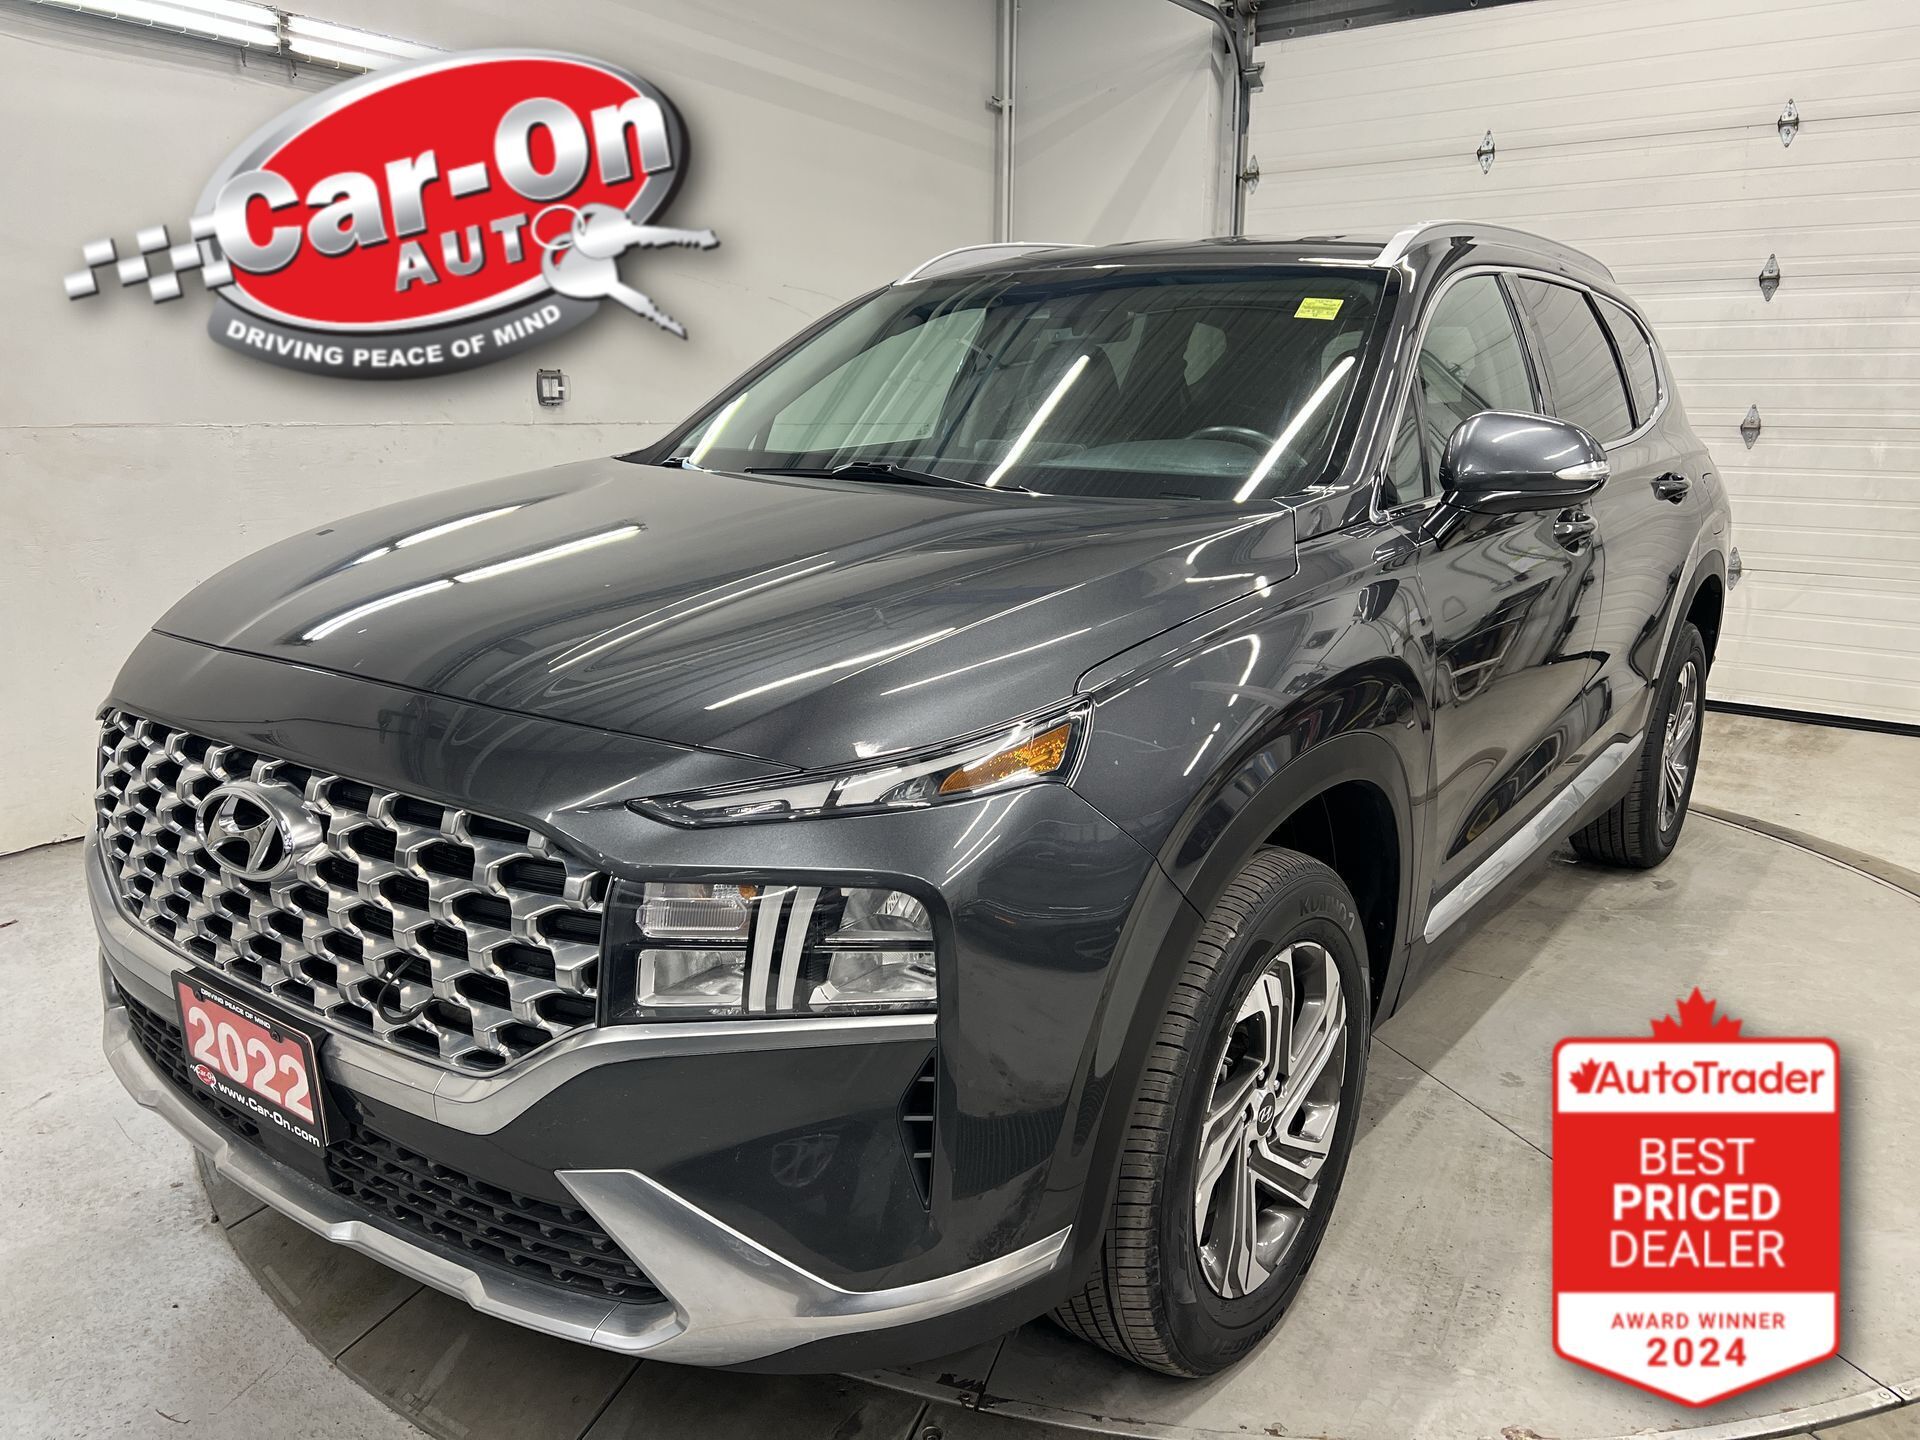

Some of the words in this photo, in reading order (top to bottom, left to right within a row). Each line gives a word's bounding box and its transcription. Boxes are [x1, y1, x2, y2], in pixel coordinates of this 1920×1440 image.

[200, 987, 224, 1005] DRIVING
[224, 1000, 245, 1016] PEACE
[245, 1011, 254, 1020] OF
[254, 1015, 271, 1029] MIND
[188, 1006, 315, 1125] 2022
[217, 1082, 321, 1148] www.Car-On.com
